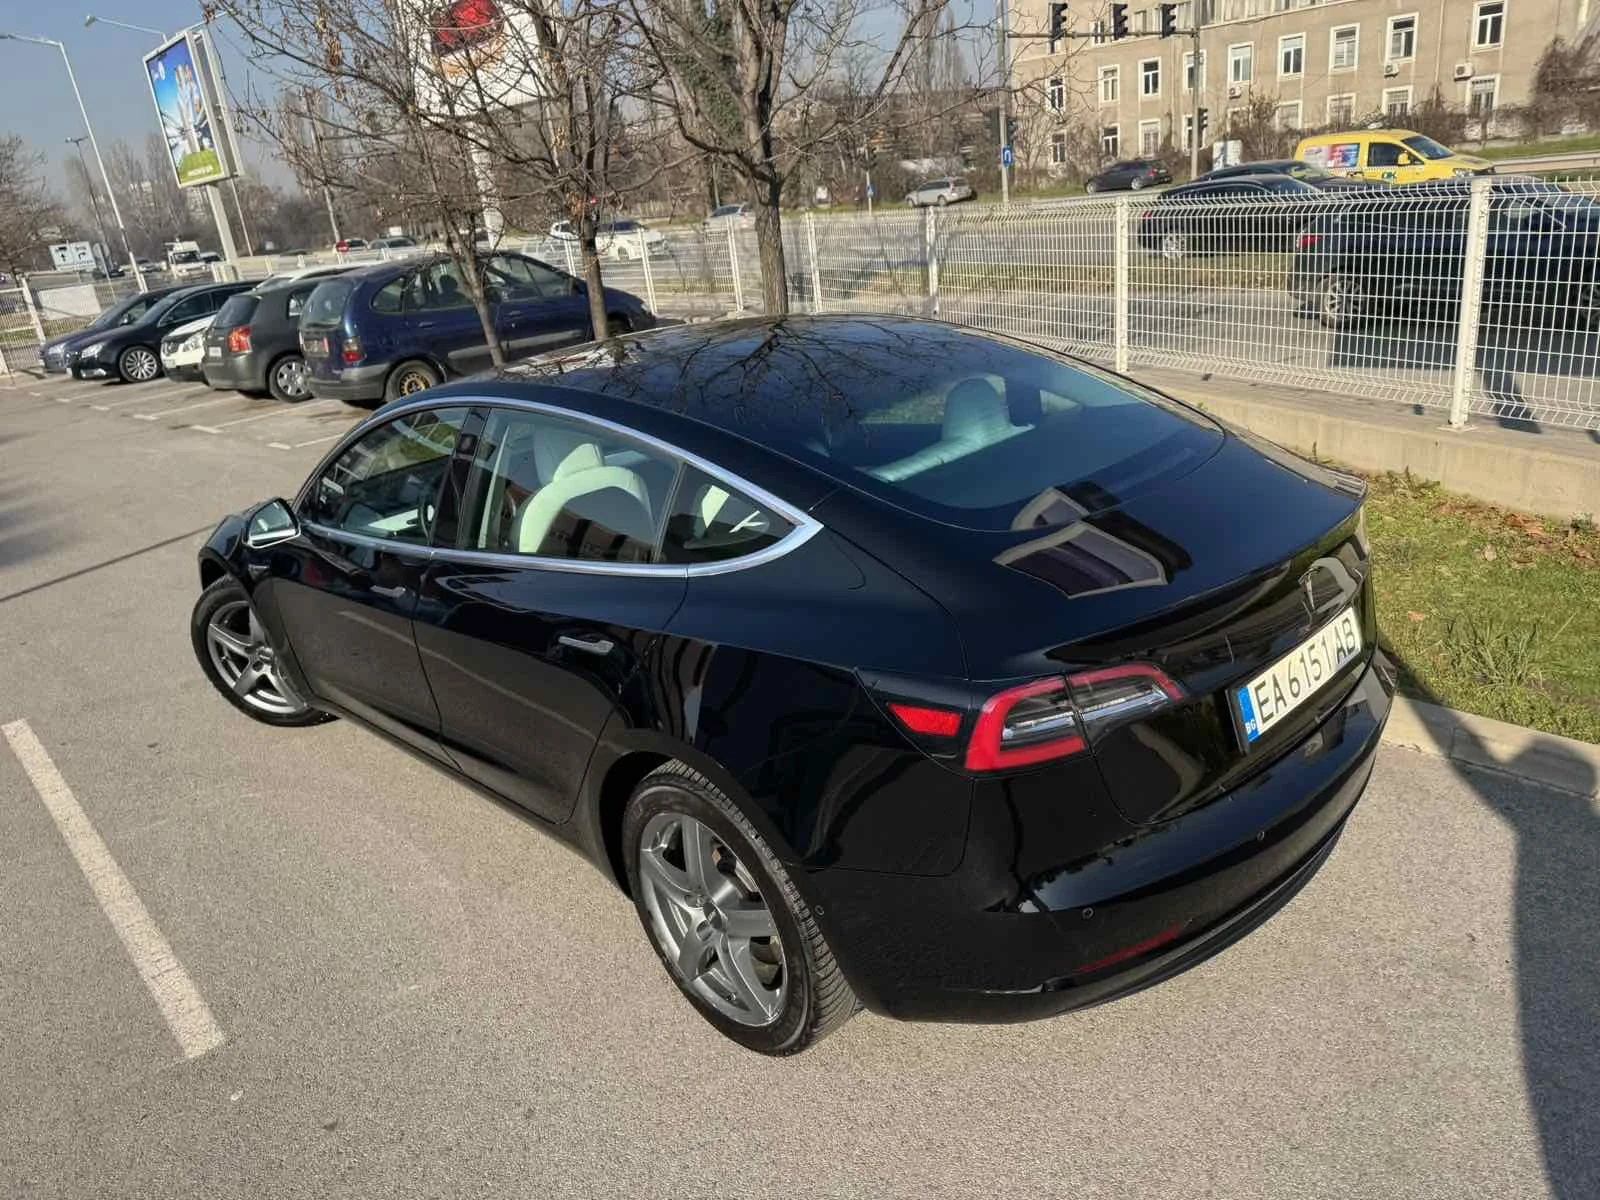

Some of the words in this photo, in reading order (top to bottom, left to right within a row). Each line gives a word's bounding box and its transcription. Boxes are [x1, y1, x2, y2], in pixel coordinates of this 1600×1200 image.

[1254, 673, 1287, 725] EA
[1288, 636, 1332, 699] 6151
[1334, 617, 1356, 665] AB
